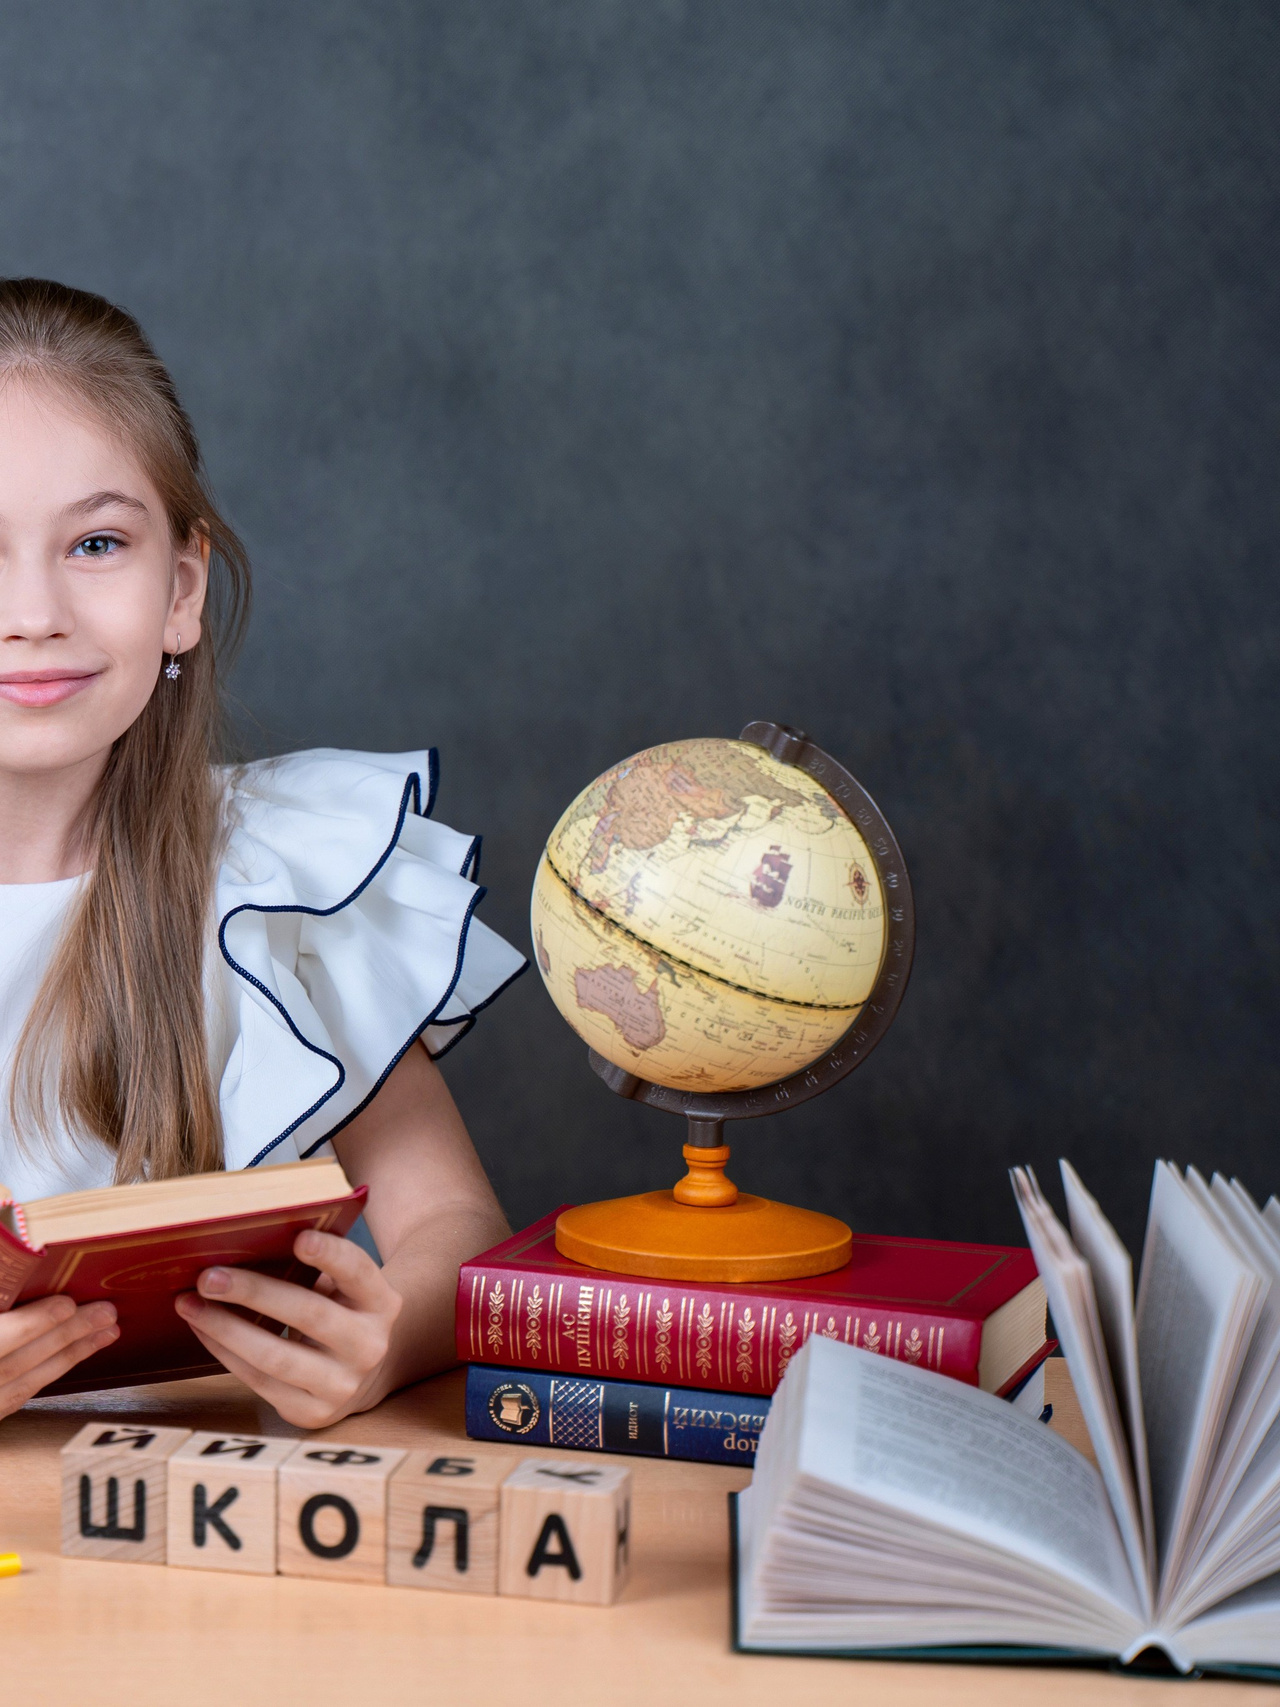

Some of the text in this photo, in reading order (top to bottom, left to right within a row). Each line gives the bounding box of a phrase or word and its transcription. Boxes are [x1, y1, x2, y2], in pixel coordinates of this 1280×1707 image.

[783, 895, 827, 916] NORTH
[830, 907, 867, 921] PACIFIC
[577, 1285, 594, 1368] ПУШКИН
[627, 1401, 639, 1440] ИДИОТ
[91, 1427, 157, 1450] Й
[199, 1437, 268, 1460] Й
[305, 1449, 382, 1467] Ф
[425, 1457, 477, 1476] Б
